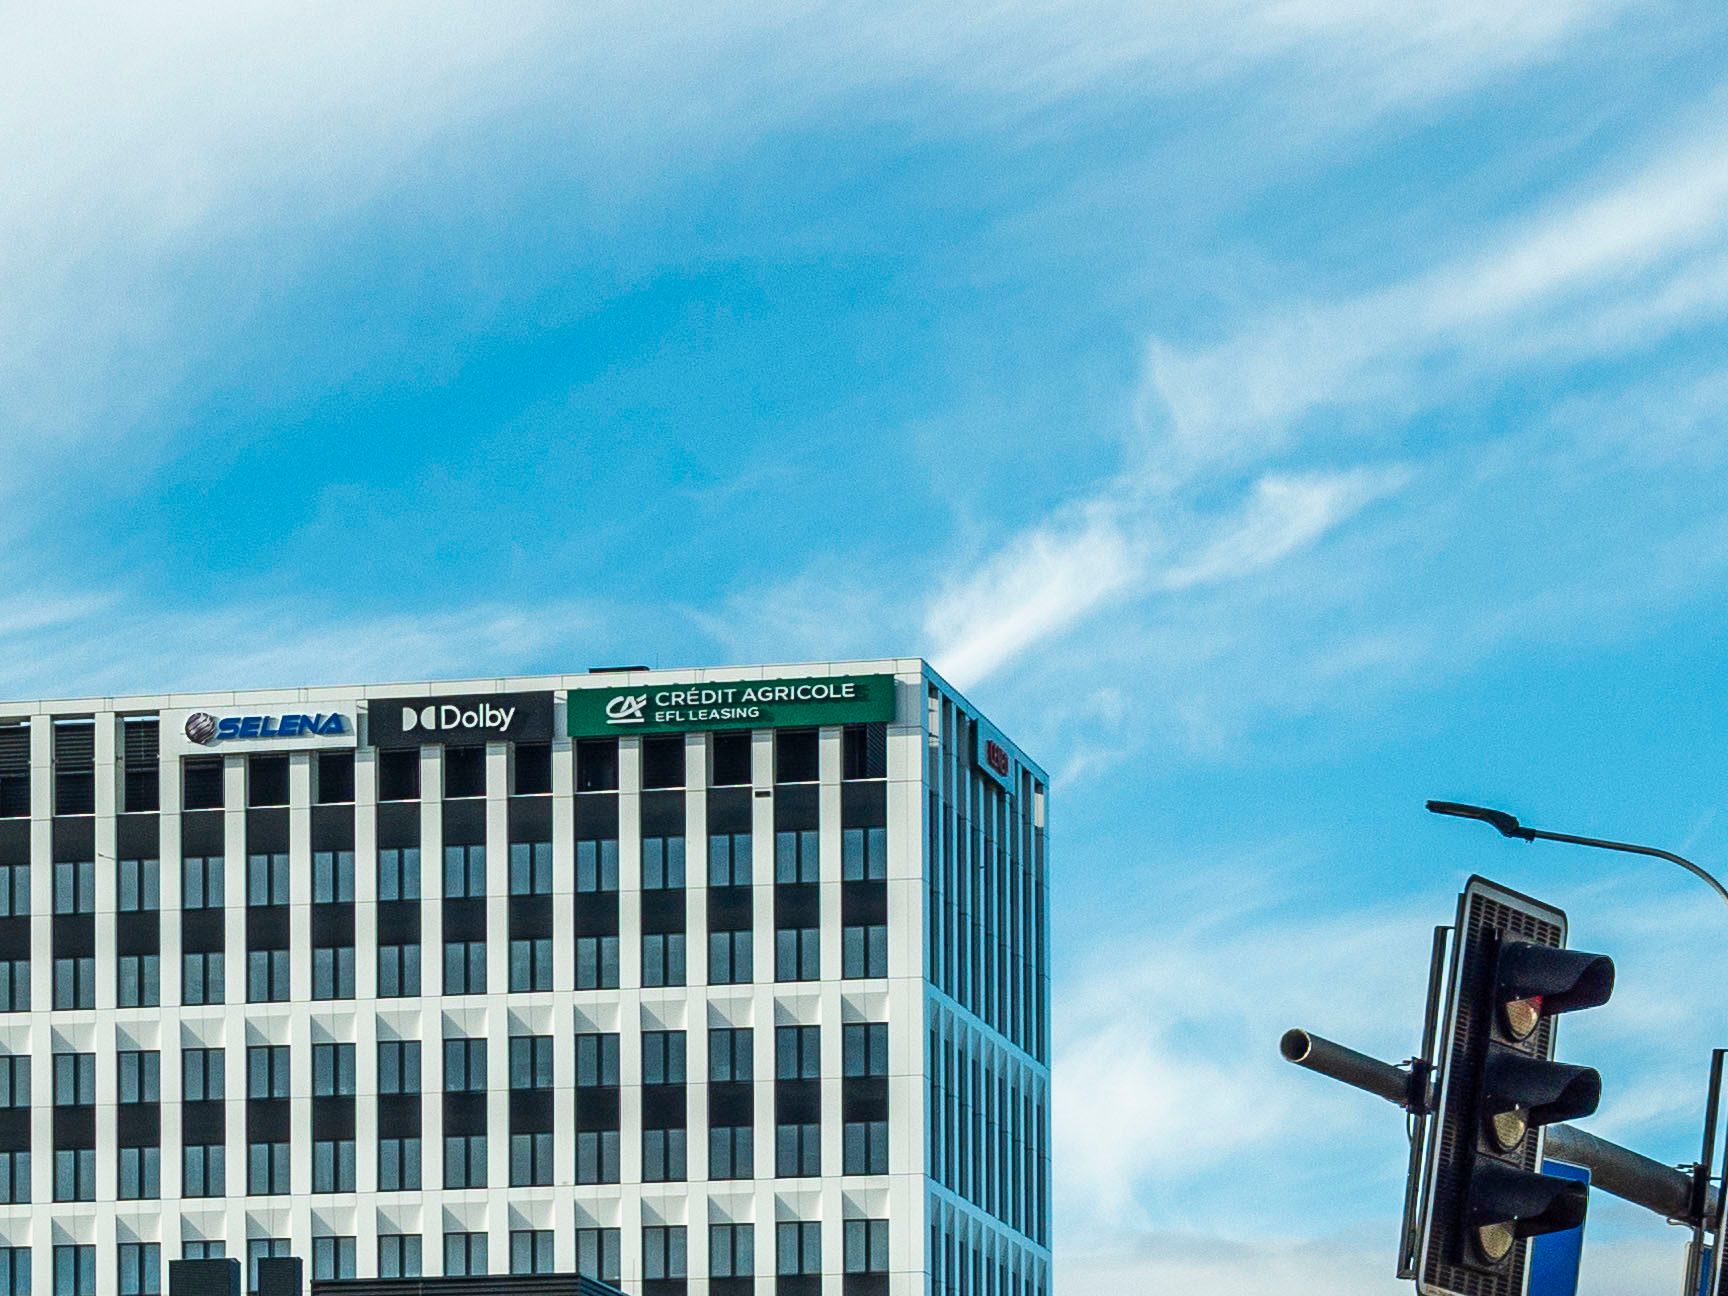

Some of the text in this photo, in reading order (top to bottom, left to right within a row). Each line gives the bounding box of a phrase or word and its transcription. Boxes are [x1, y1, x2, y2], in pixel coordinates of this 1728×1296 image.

[655, 683, 856, 707] CRÉDIT AGRICOLE
[217, 712, 346, 740] SELENA
[440, 703, 516, 732] Dolby
[655, 706, 760, 723] EFL LEASING
